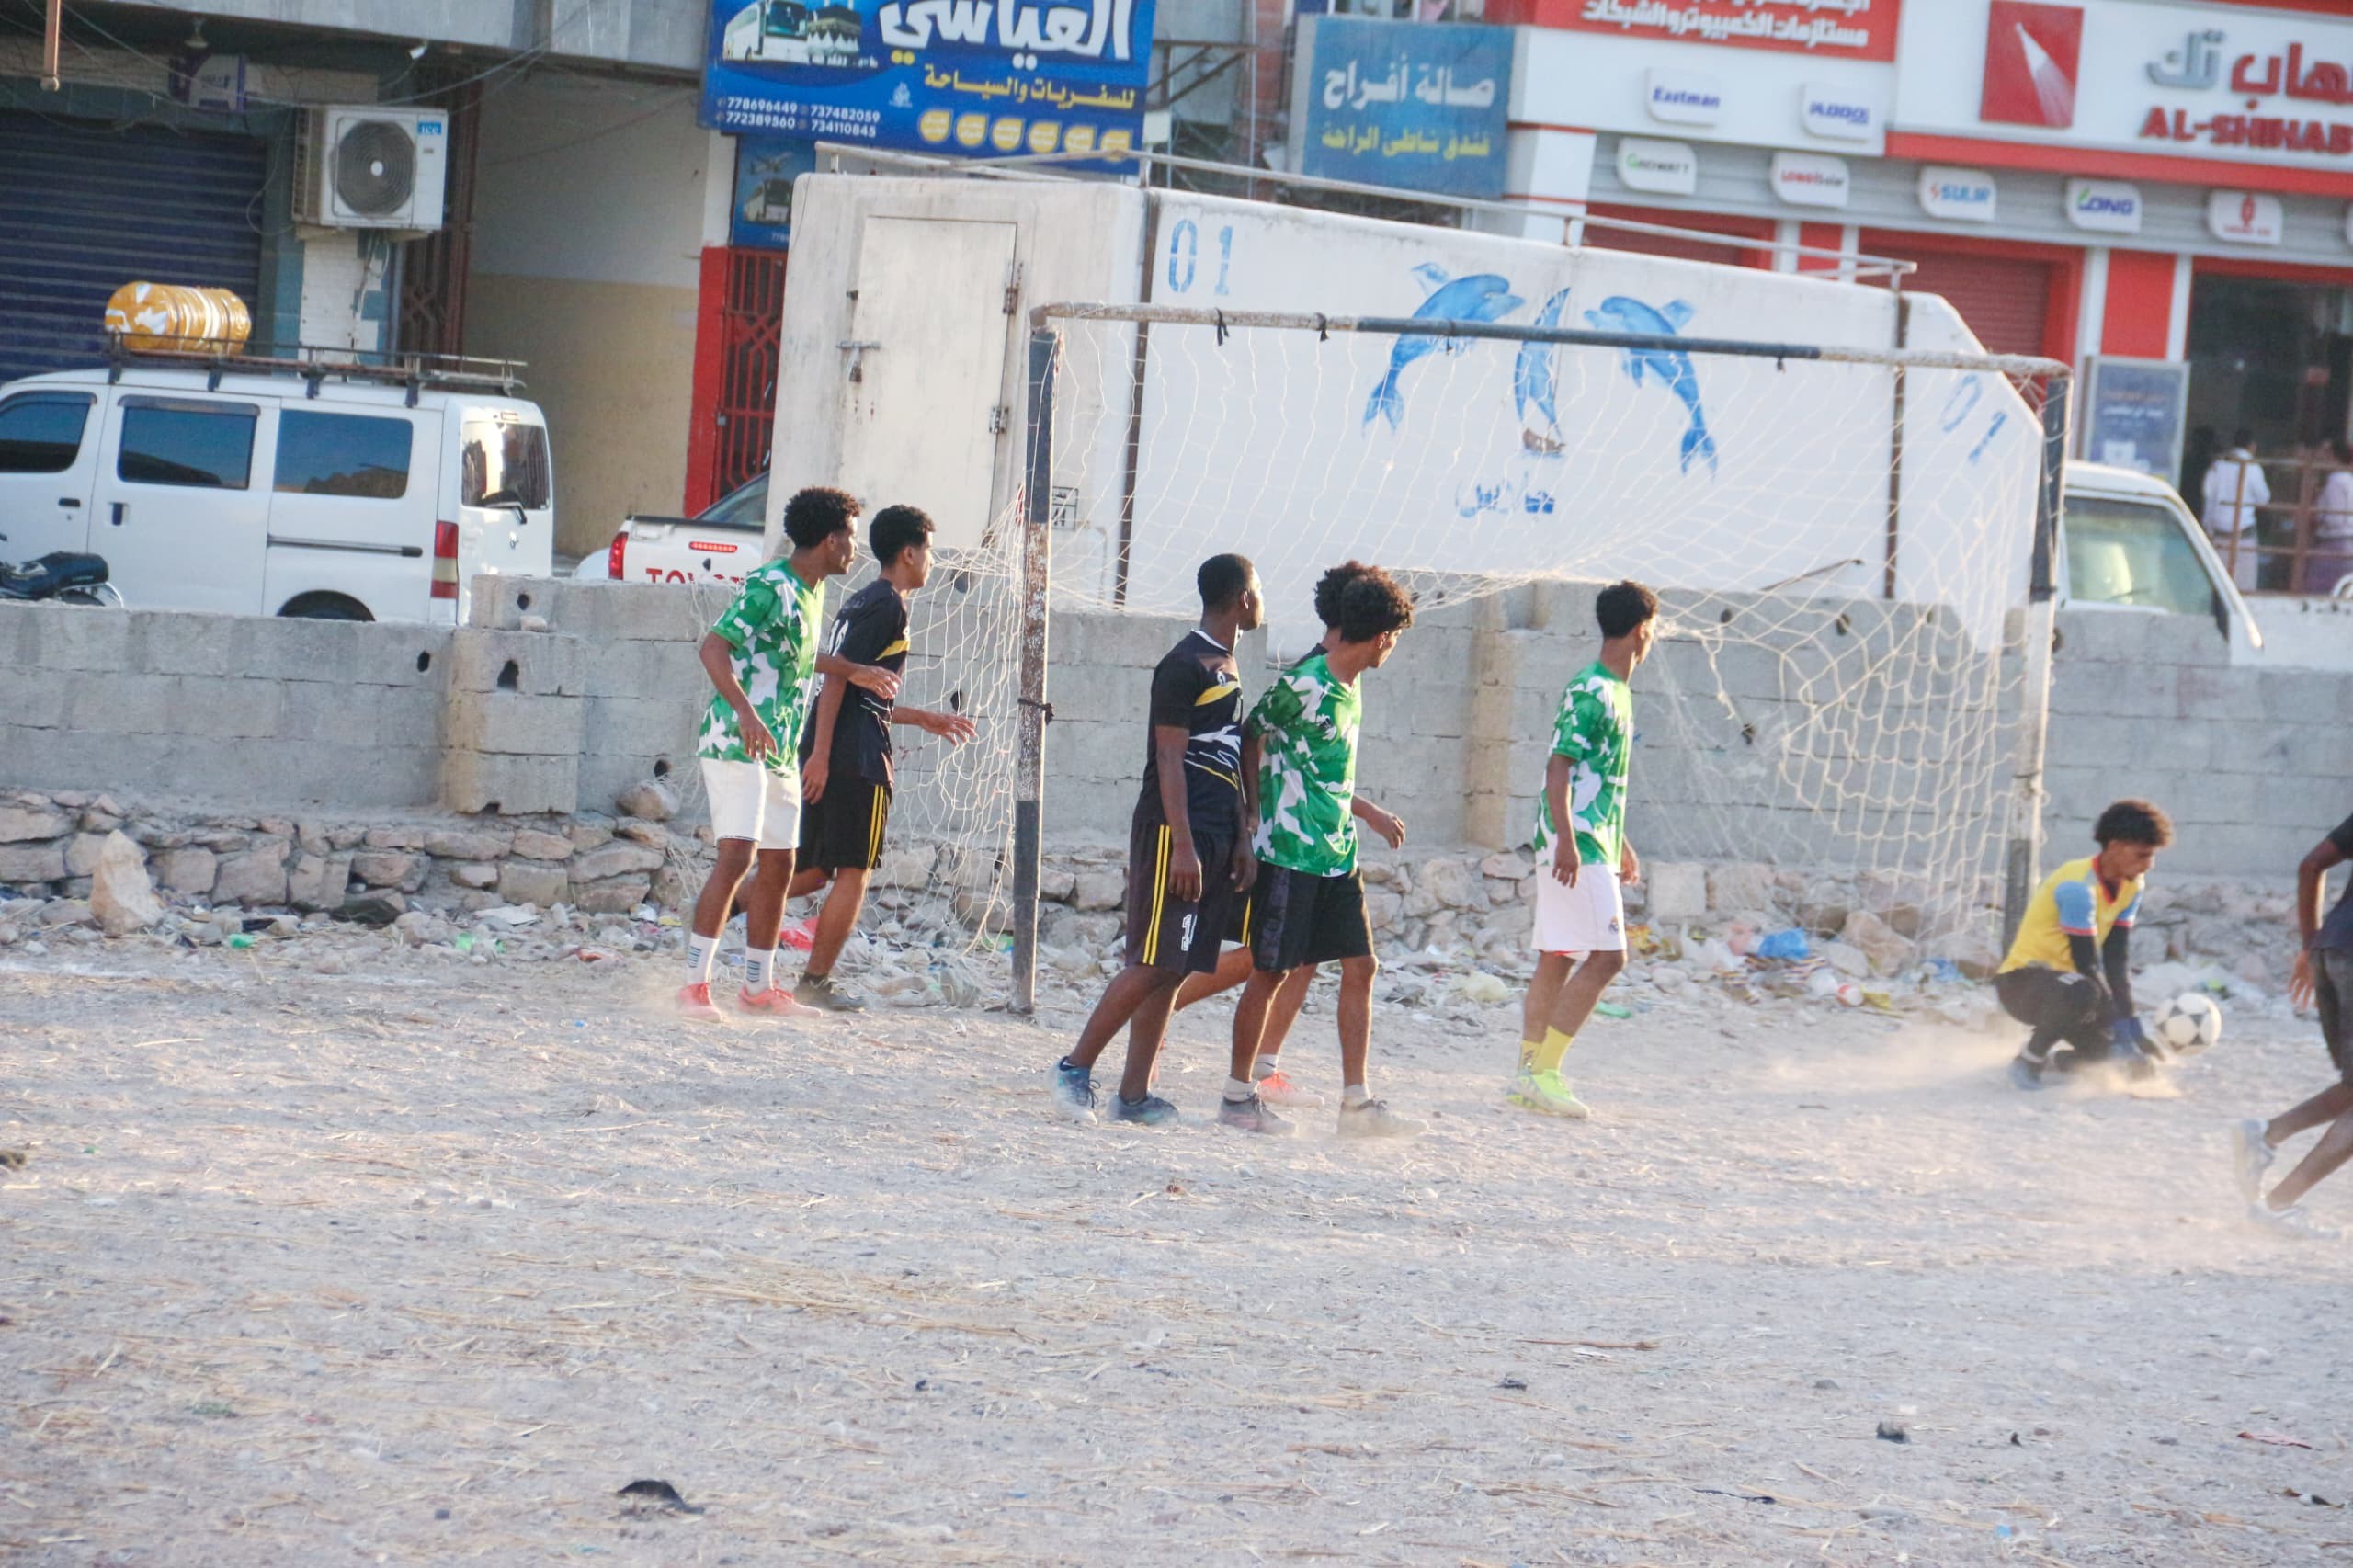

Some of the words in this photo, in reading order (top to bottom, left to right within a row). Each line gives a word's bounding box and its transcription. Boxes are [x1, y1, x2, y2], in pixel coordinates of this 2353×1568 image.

[925, 63, 1029, 103] والسياحة
[1323, 51, 1409, 110] أفراح
[1415, 62, 1496, 108] صالة
[1168, 219, 1233, 296] 01
